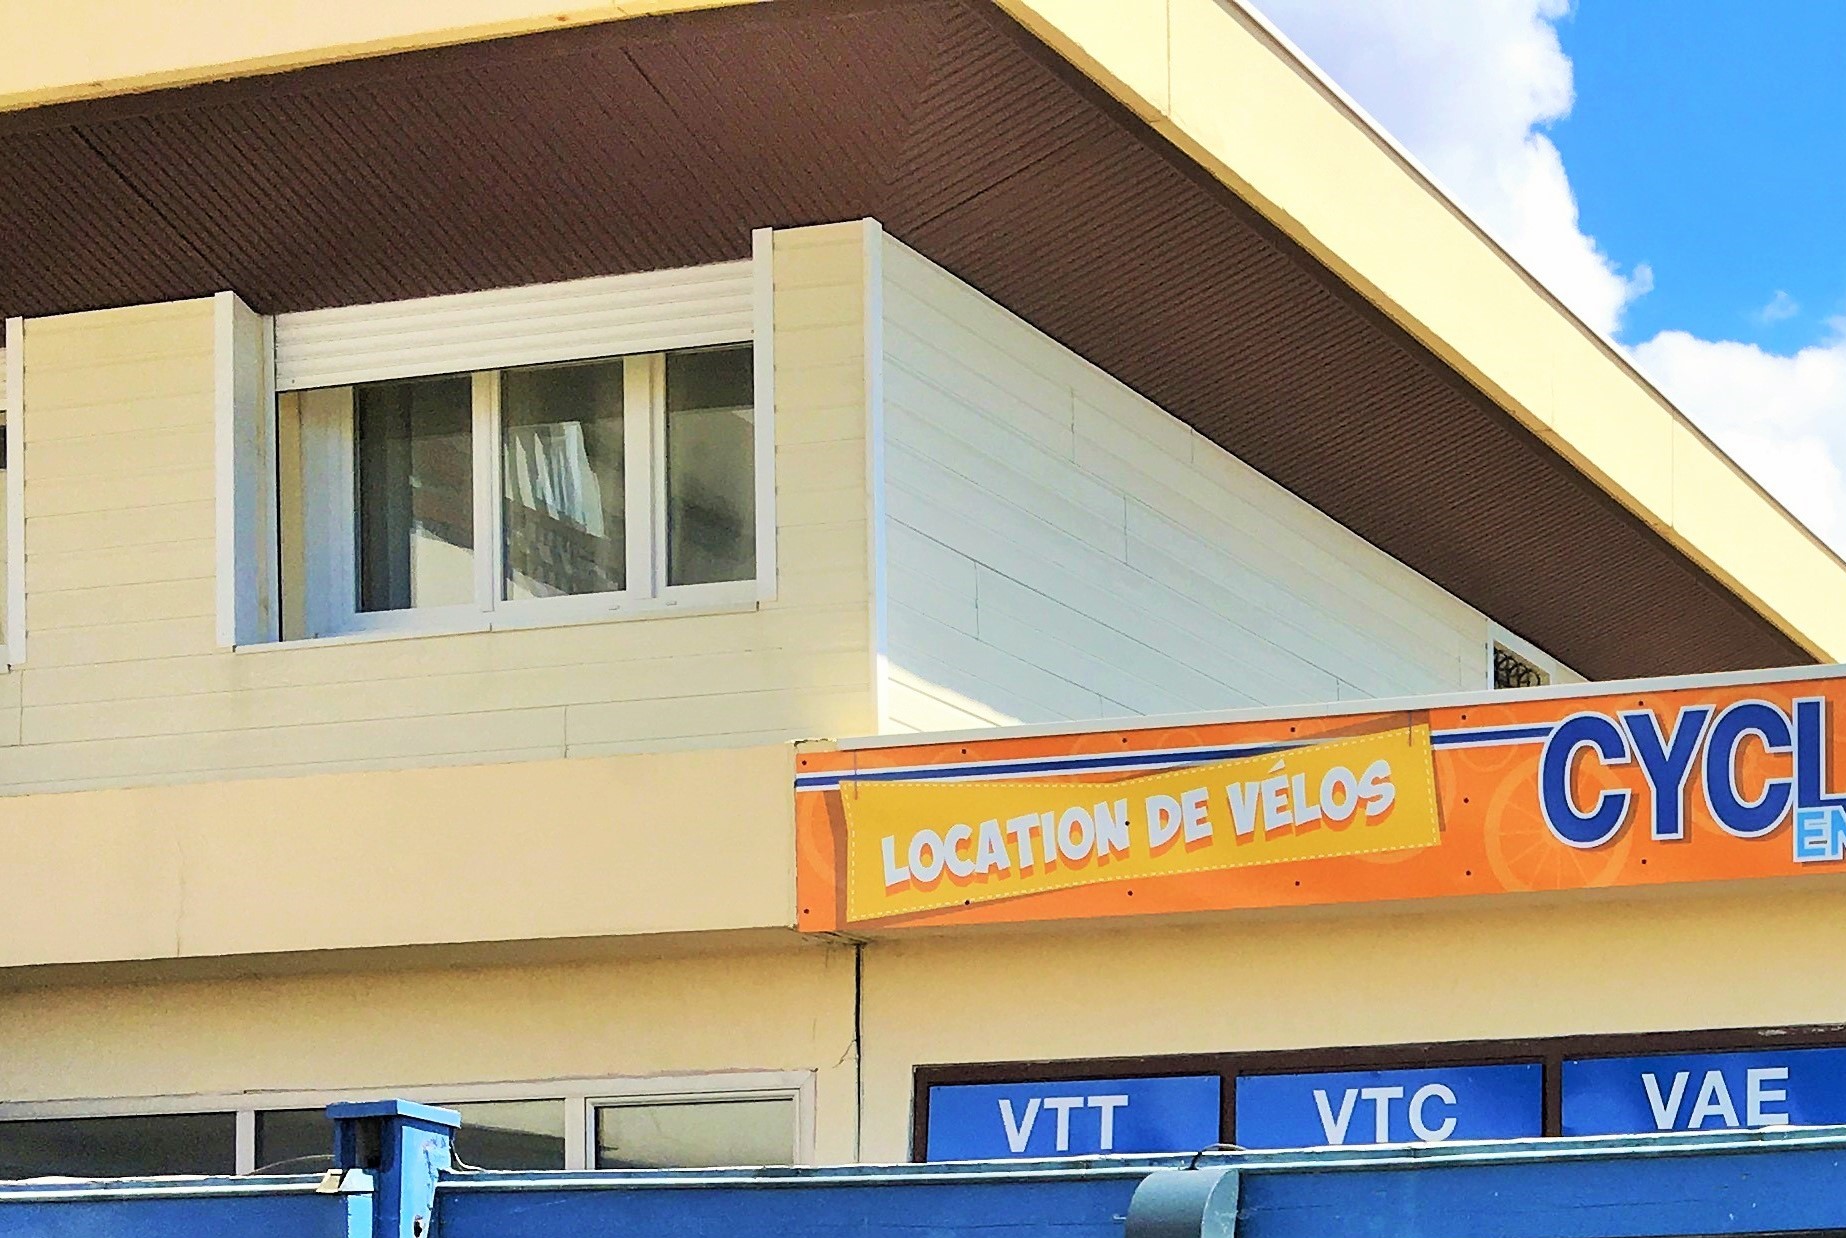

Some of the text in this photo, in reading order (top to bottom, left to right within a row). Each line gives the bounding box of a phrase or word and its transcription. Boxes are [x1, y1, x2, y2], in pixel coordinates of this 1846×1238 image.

[881, 759, 1396, 887] LOCATION DE VÉLOS
[998, 1095, 1129, 1153] VTT
[1314, 1083, 1457, 1144] VTC
[1642, 1067, 1790, 1130] VAE
